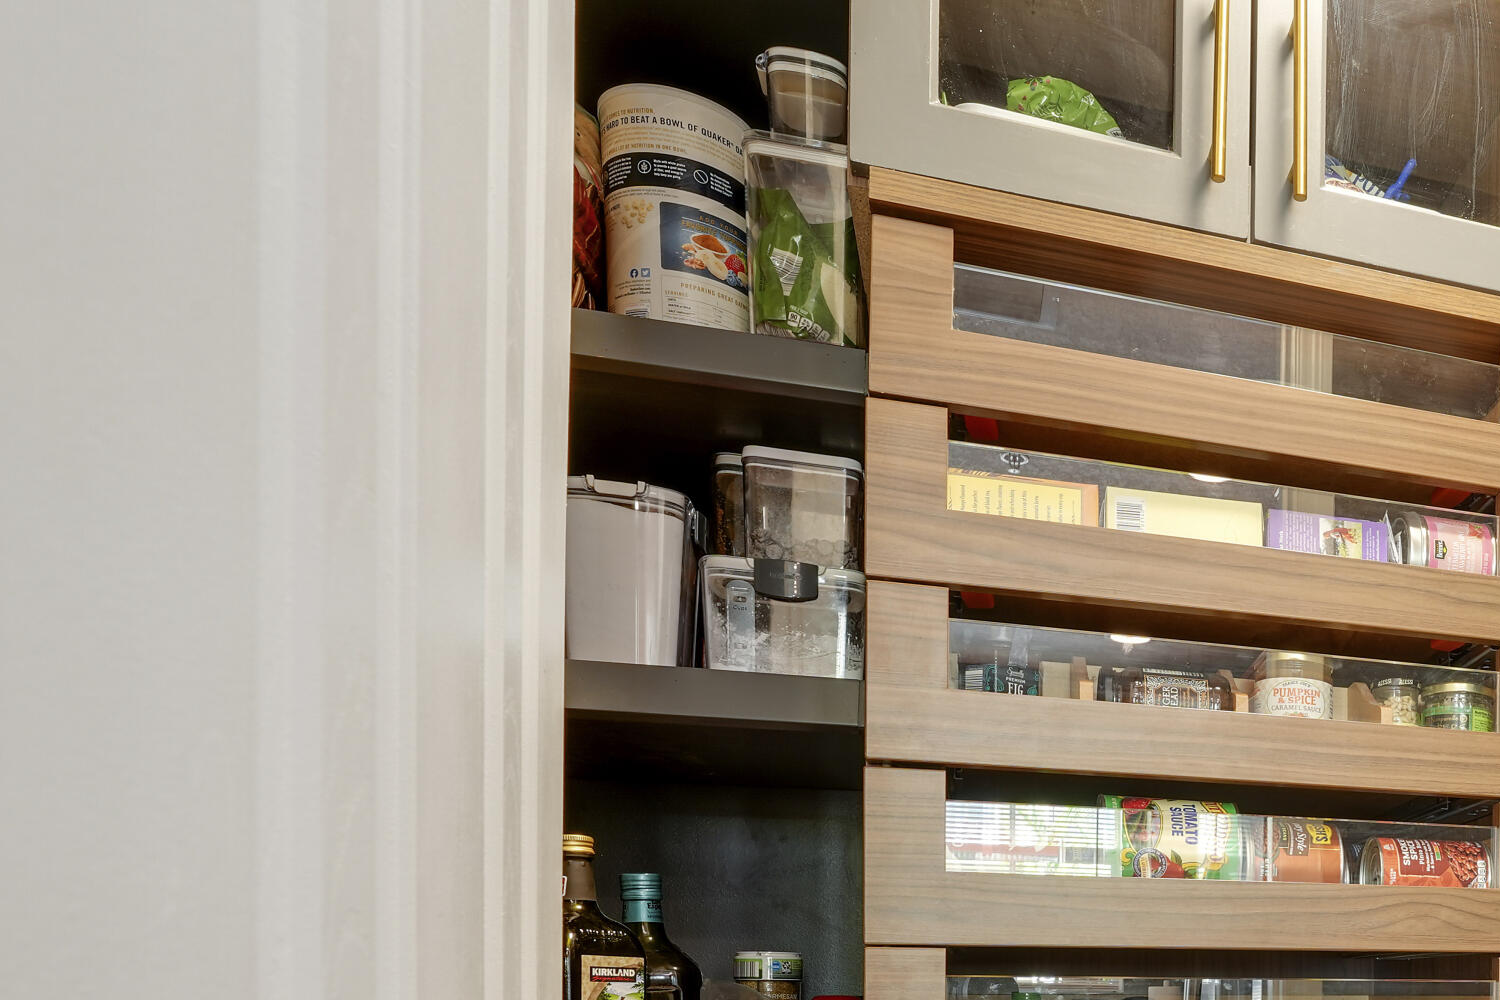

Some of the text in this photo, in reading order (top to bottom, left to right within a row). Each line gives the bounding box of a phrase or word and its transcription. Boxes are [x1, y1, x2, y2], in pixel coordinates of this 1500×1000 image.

[620, 116, 629, 126] TO
[630, 115, 650, 125] BEAT
[652, 116, 658, 124] A
[660, 117, 685, 129] BOWL
[687, 123, 698, 132] OF
[1005, 676, 1026, 684] PREMIUM
[1008, 682, 1024, 695] FIG
[1273, 687, 1320, 698] PUMPKIN
[1288, 696, 1316, 706] SPICE
[1271, 704, 1321, 713] CARAMEL SAUCE
[1169, 806, 1184, 837] SAUCE
[1182, 803, 1199, 845] TOMATO
[1295, 832, 1307, 853] Style
[591, 967, 636, 977] KIRKLAND
